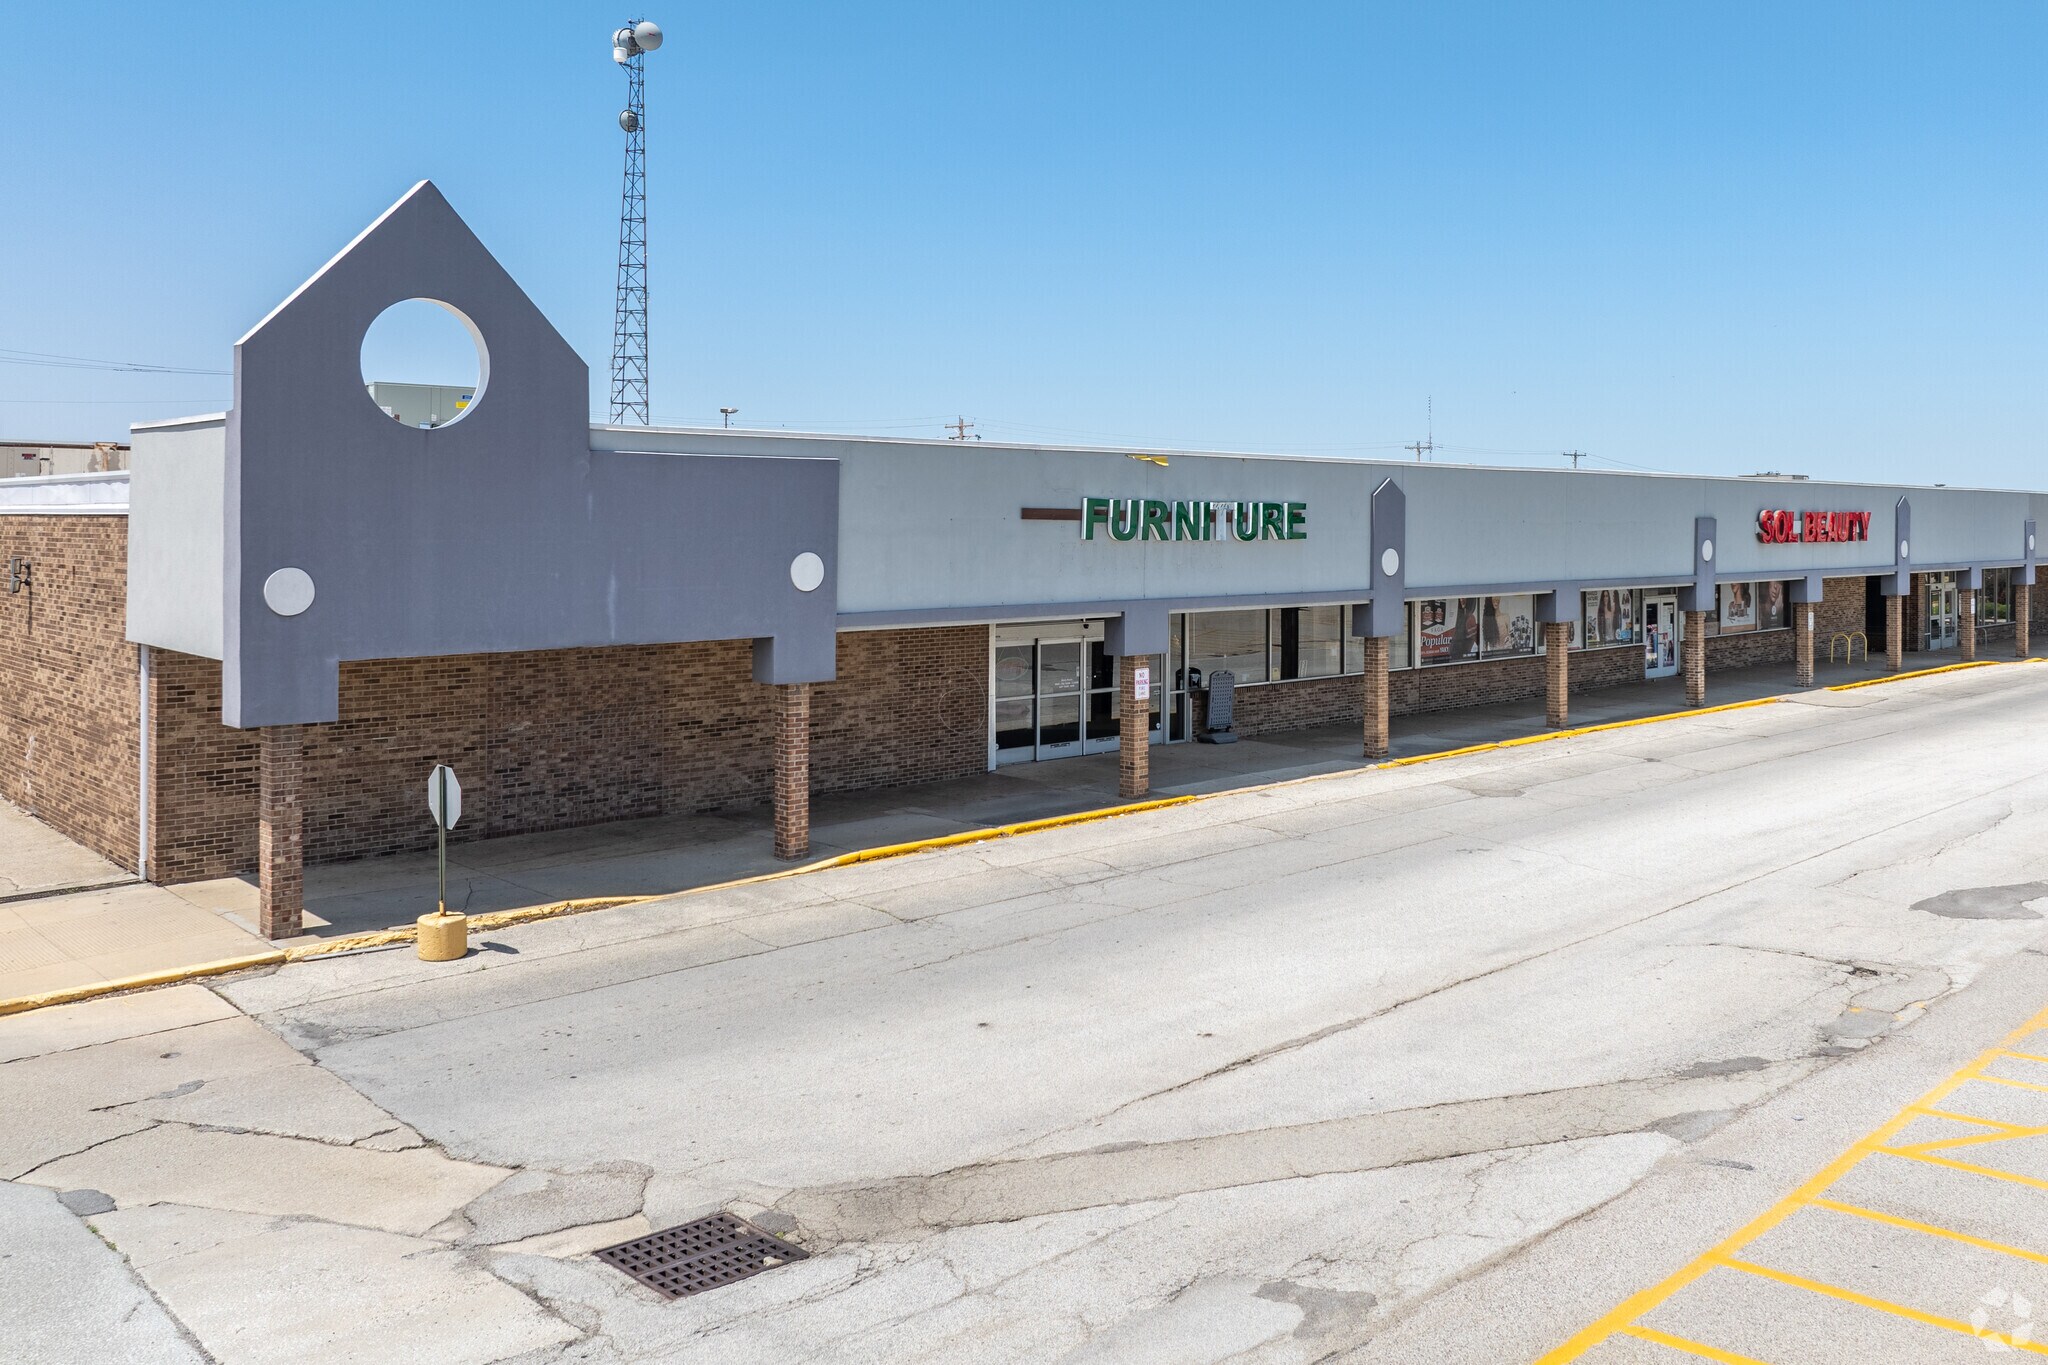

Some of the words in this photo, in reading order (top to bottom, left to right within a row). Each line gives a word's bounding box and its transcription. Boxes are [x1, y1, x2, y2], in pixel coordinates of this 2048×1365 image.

[1081, 498, 1307, 541] FURNITURE
[1758, 509, 1799, 544] SOL
[1802, 511, 1872, 543] BEAUTY
[1421, 634, 1452, 649] Popular
